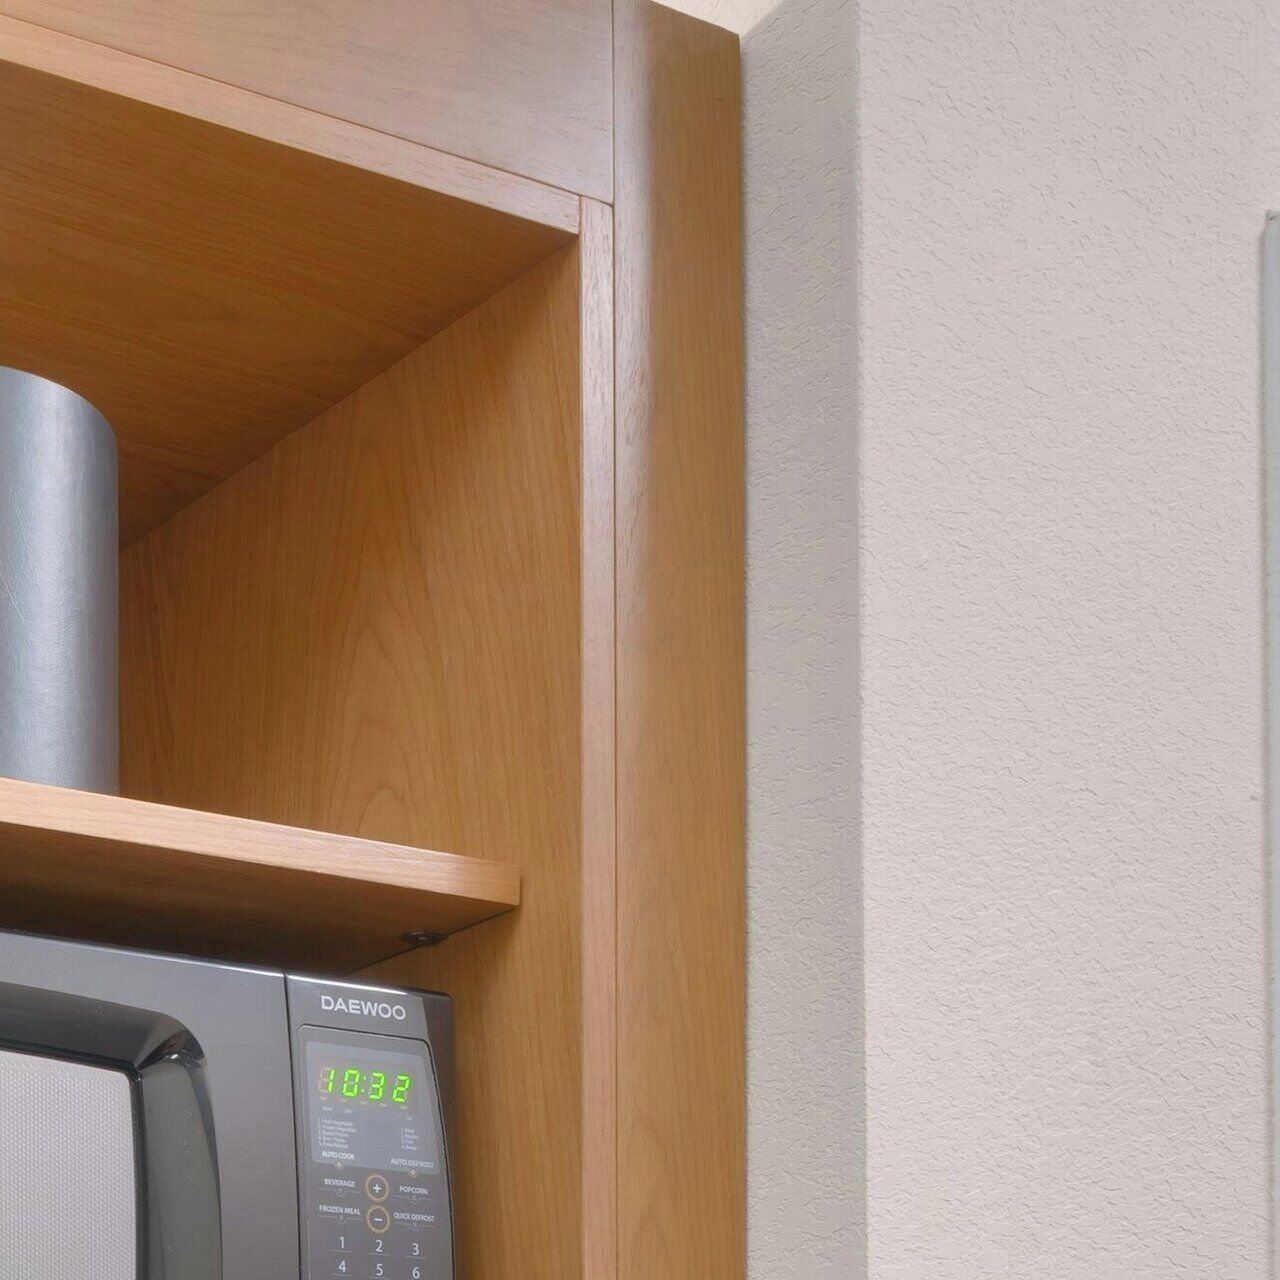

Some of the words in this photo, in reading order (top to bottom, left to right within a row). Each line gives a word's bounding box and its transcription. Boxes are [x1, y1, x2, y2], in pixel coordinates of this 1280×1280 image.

[321, 996, 406, 1020] DAEWOO
[325, 1067, 412, 1103] 10:32
[324, 1178, 355, 1188] BEVERAGE
[399, 1185, 428, 1195] POPCORN
[319, 1204, 344, 1214] FROZEN
[344, 1207, 361, 1215] MEAL
[339, 1236, 345, 1249] 1
[375, 1239, 383, 1252] 2
[412, 1243, 420, 1256] 3
[338, 1260, 347, 1273] 4
[376, 1263, 384, 1276] 5
[412, 1266, 420, 1279] 6
